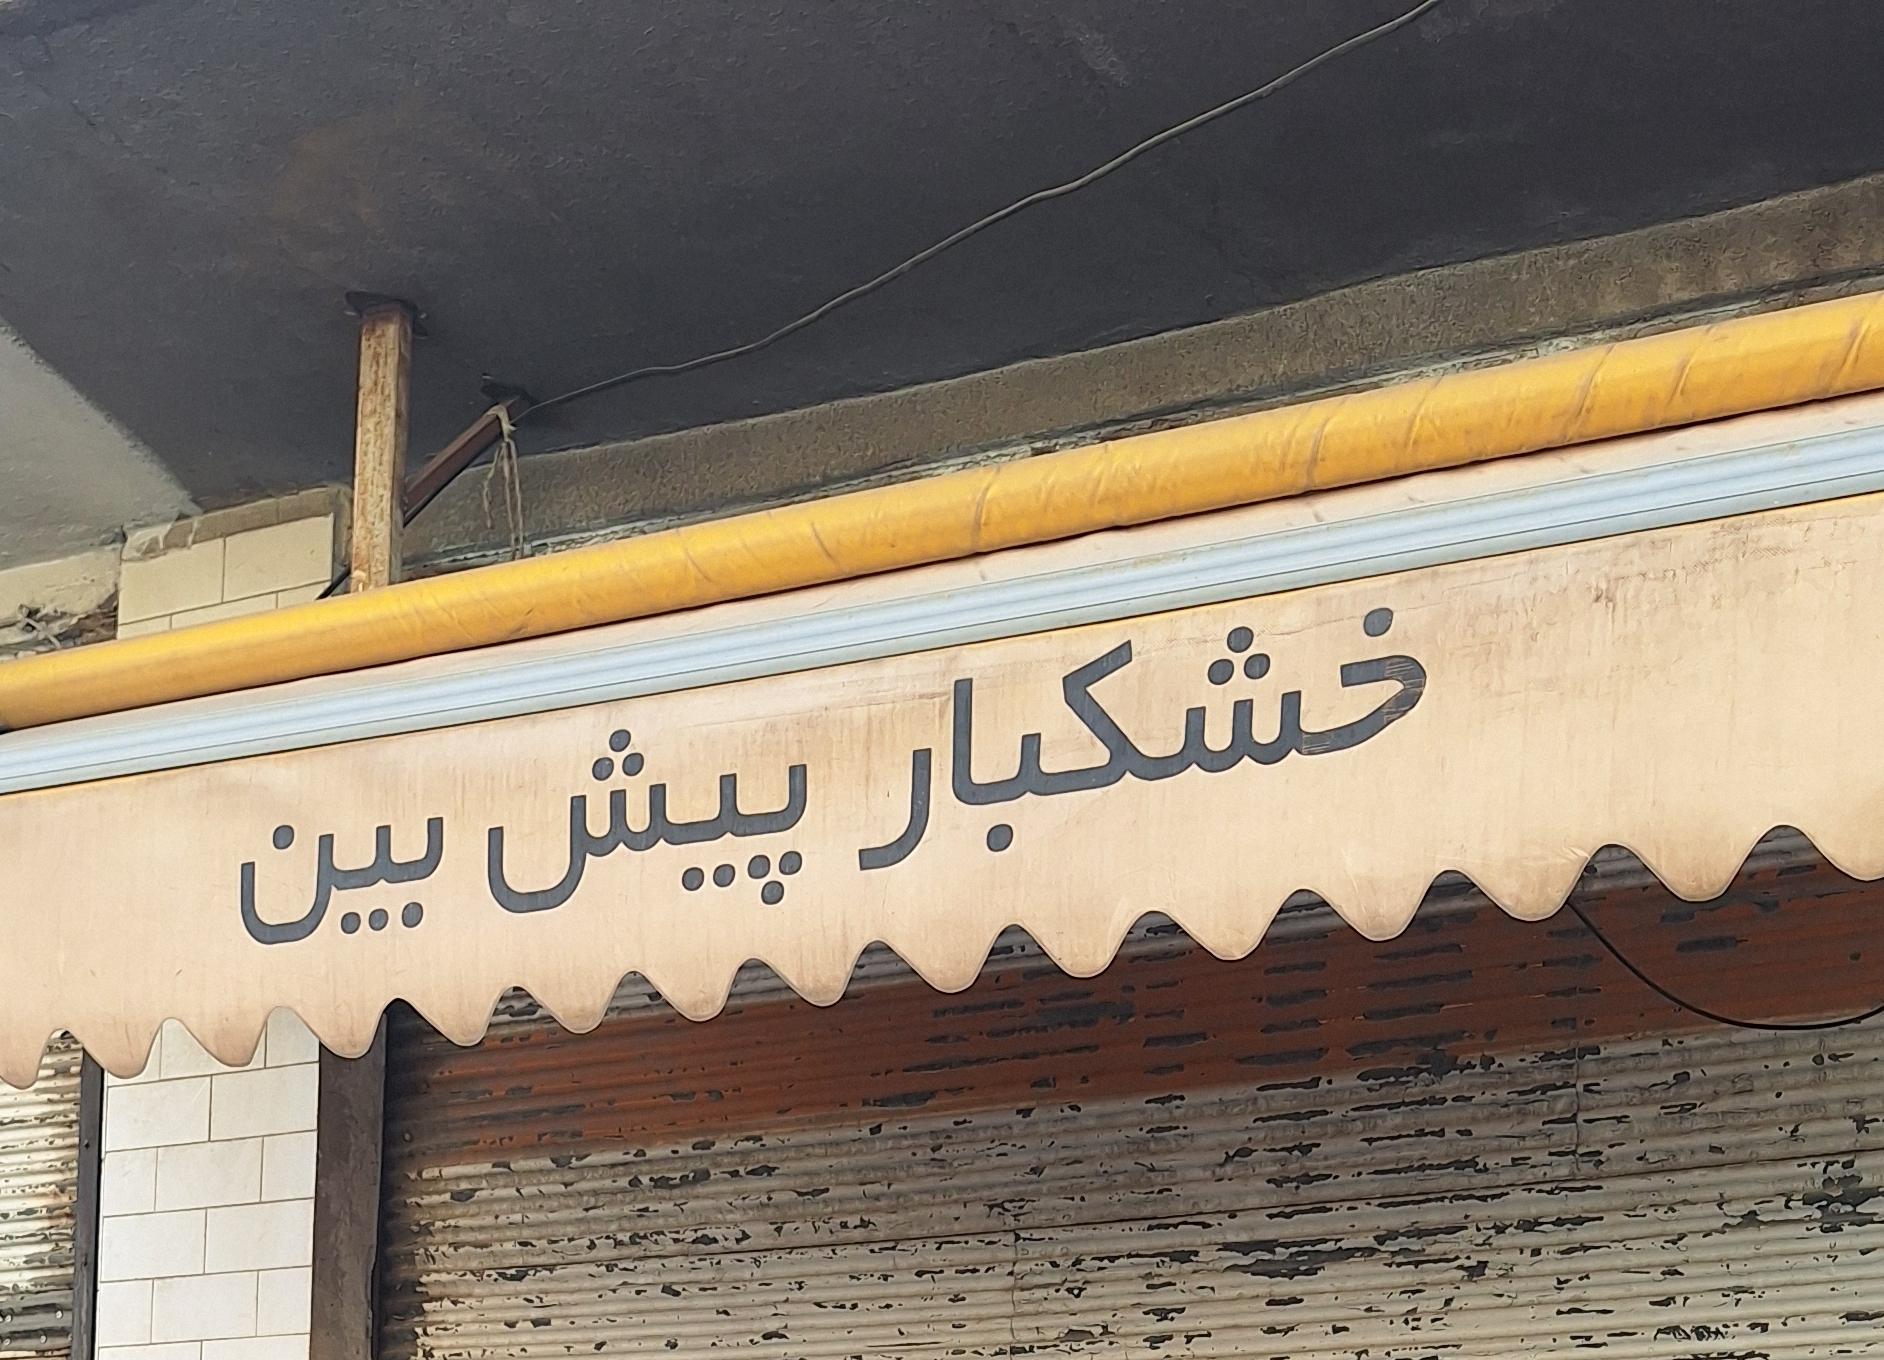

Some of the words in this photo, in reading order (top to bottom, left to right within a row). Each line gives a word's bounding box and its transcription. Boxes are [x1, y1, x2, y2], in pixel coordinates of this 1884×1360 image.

[486, 730, 810, 914] پیش
[859, 607, 1427, 871] خشکبار
[240, 815, 446, 947] بین
